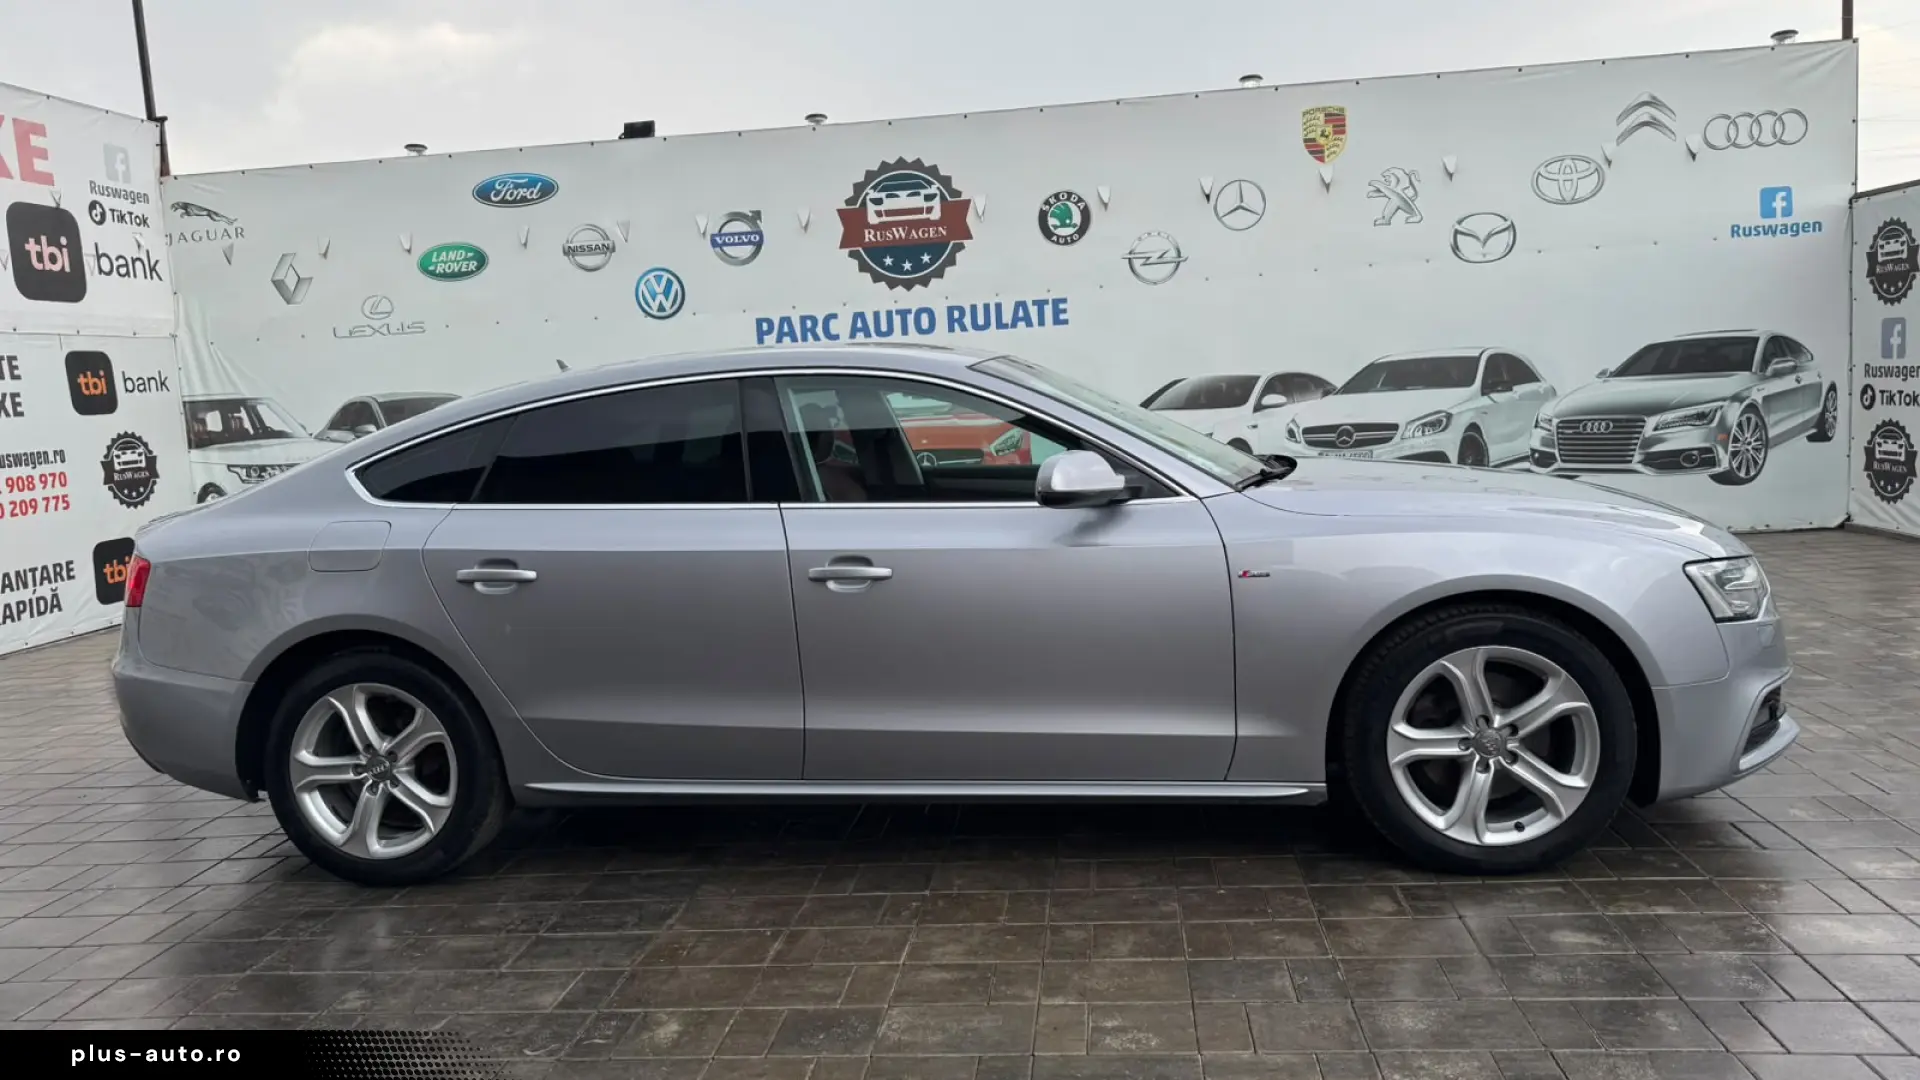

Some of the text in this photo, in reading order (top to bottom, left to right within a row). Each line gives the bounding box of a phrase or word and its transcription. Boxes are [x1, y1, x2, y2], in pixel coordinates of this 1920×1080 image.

[89, 180, 150, 205] Ruswagen
[490, 178, 541, 202] Ford
[109, 207, 151, 228] TikTok
[168, 226, 245, 247] JAGUAR
[715, 233, 760, 245] VOLVO
[1051, 233, 1080, 244] AUTO
[1730, 220, 1823, 238] Ruswagen
[431, 250, 465, 263] LAND
[567, 242, 610, 253] NISSAN
[24, 235, 164, 282] tbi bank
[435, 260, 478, 274] ROVER
[333, 321, 426, 338] LEXUS
[755, 297, 1070, 345] PARC AUTO RULATE
[77, 369, 170, 396] tbi bank
[5, 471, 68, 494] 908 970
[9, 498, 38, 518] 209
[41, 493, 70, 513] 775
